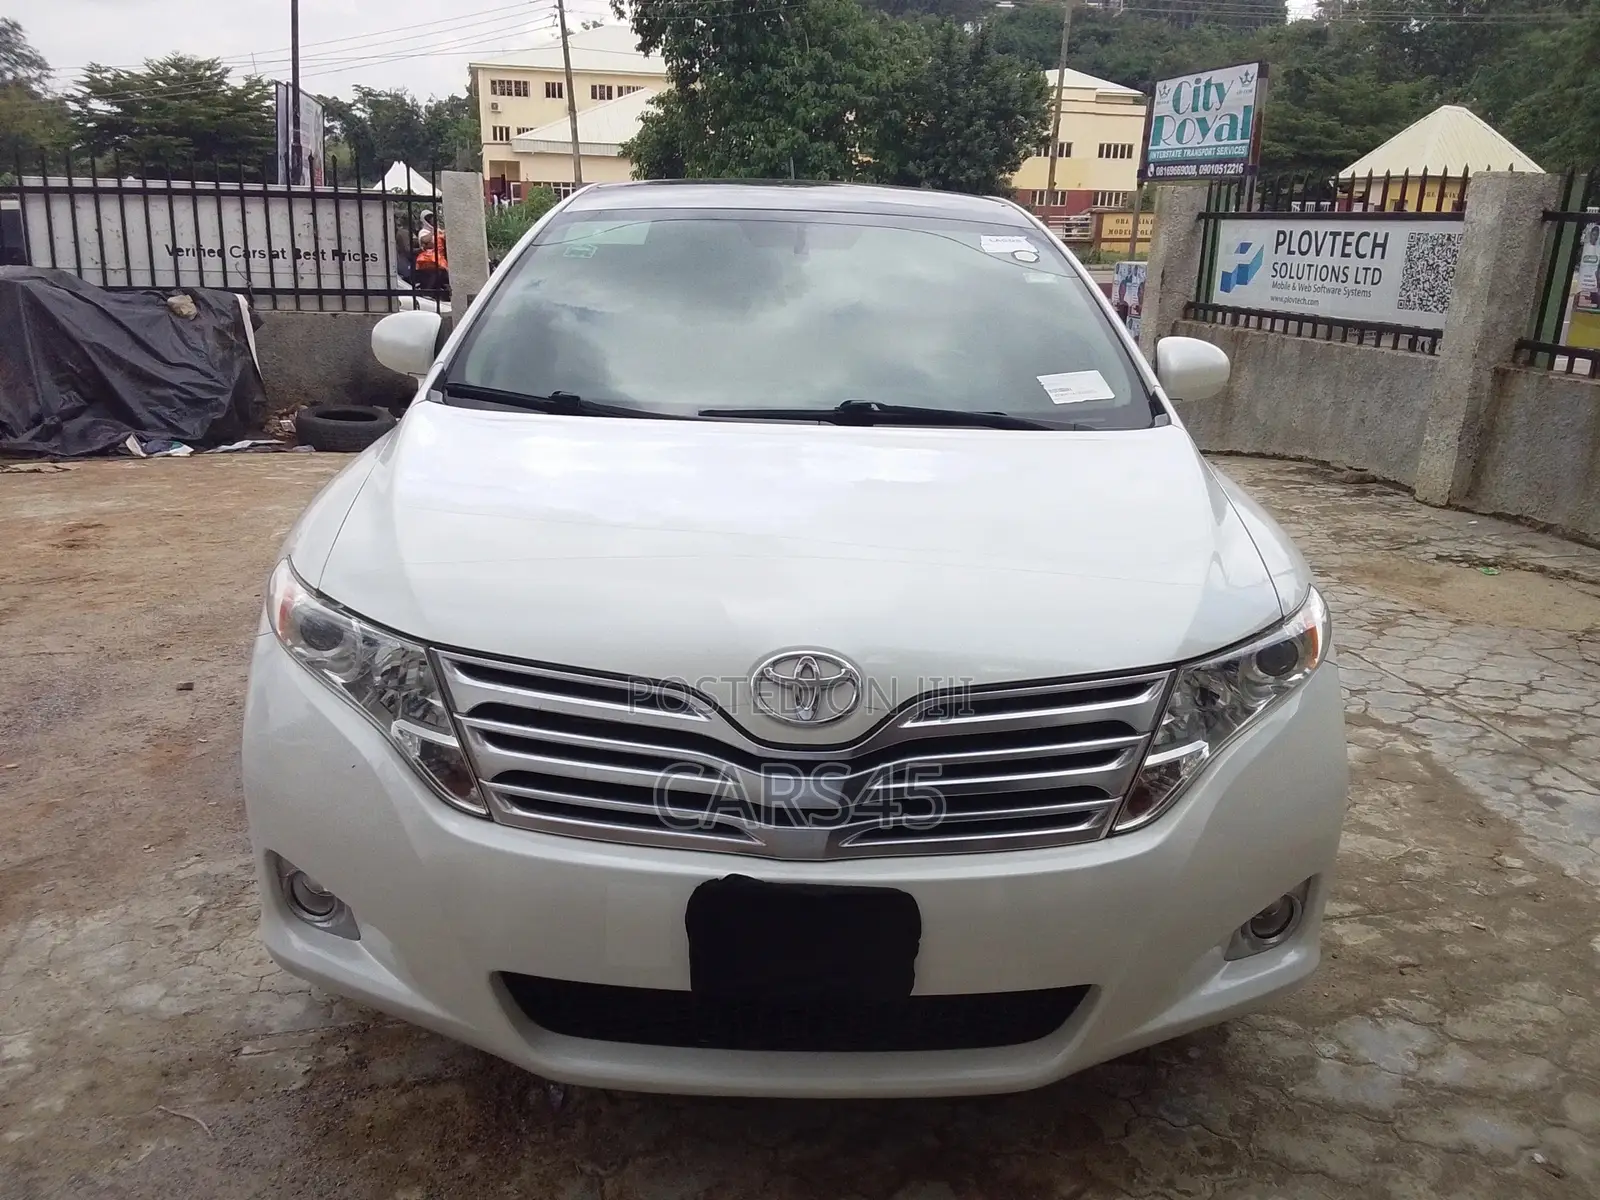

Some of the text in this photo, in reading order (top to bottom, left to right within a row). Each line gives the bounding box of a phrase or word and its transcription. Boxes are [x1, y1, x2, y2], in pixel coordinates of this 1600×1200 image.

[1172, 76, 1234, 115] City
[1151, 105, 1252, 145] Royal
[1183, 147, 1215, 158] TRANSPORT
[229, 245, 267, 259] Cars
[269, 247, 287, 260] at
[331, 249, 378, 263] Prices
[1274, 230, 1390, 260] PLOVTECH
[1271, 262, 1383, 287] SOLUTIONS LTD
[1271, 280, 1291, 291] Mobile
[1298, 283, 1312, 293] Web
[1312, 284, 1342, 296] Software
[1343, 286, 1372, 299] Systems
[1270, 295, 1320, 307] www.plovtech.com
